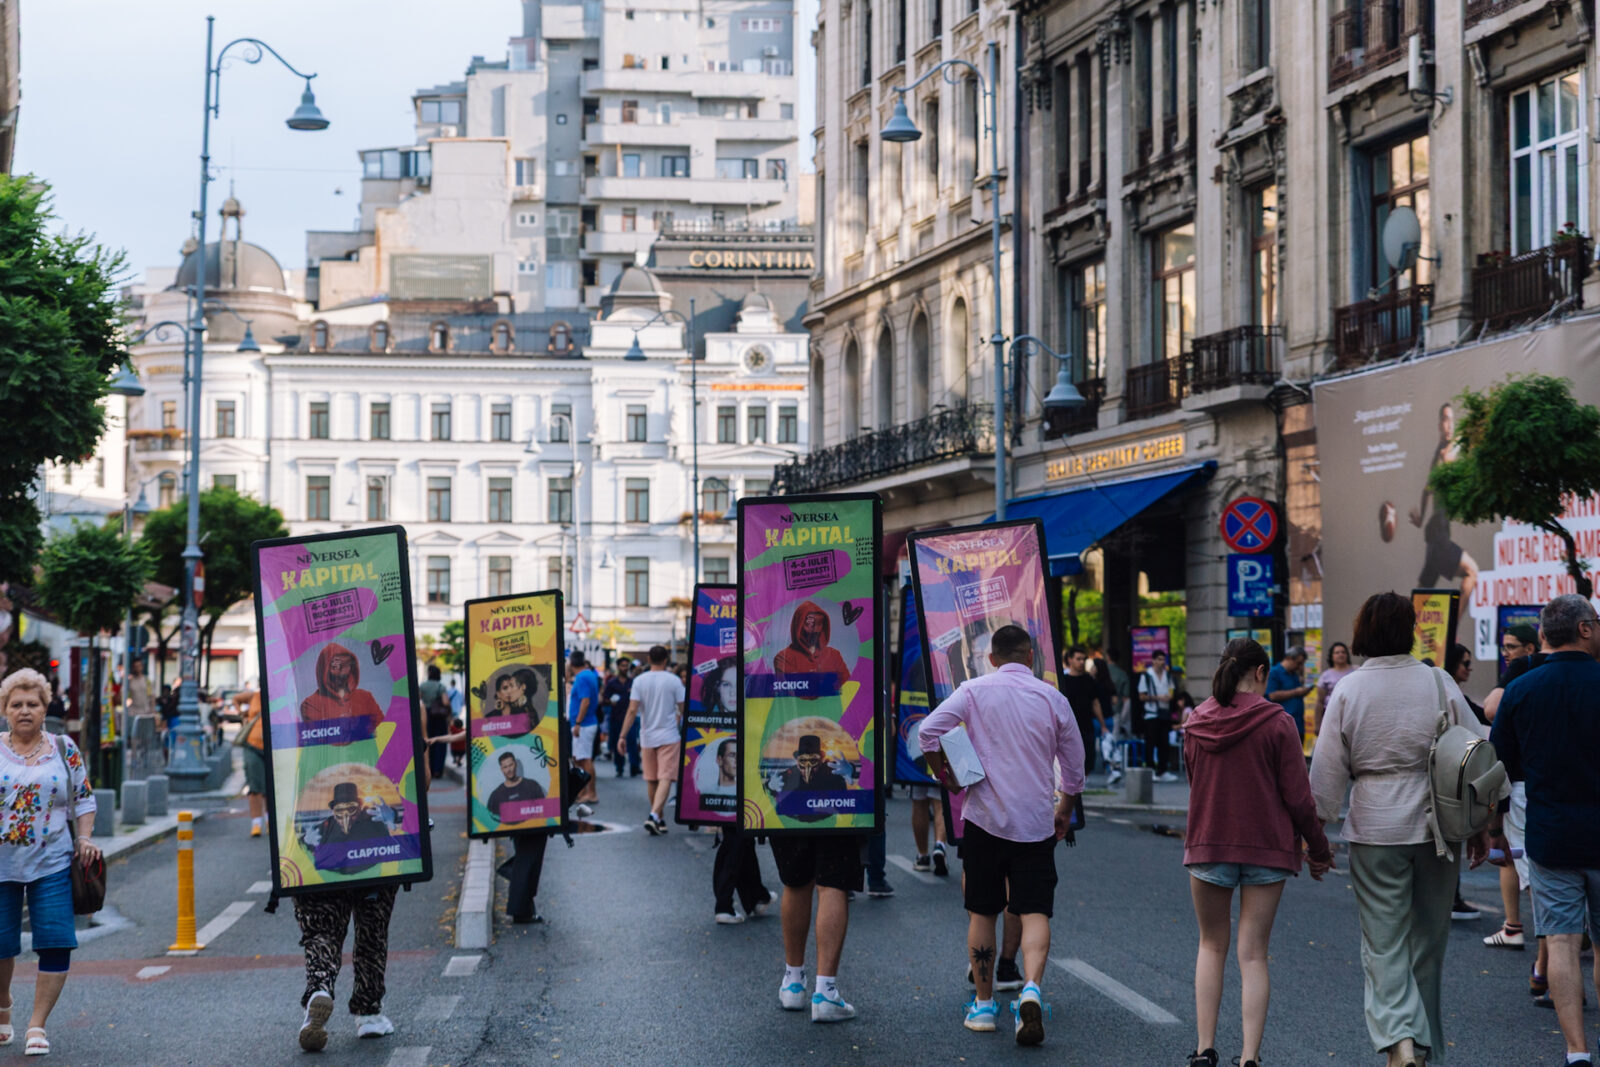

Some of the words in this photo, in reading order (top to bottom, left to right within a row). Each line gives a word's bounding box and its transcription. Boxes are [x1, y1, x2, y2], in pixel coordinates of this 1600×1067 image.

[688, 250, 815, 268] CORINTHIA
[780, 512, 839, 523] NEVERSEA
[765, 526, 854, 547] KAPITAL
[949, 538, 1004, 551] NEVERSEA
[1498, 539, 1514, 566] NU
[1518, 535, 1538, 564] FAC
[296, 549, 361, 565] NEVERSEA
[791, 561, 806, 569] 4-6
[808, 556, 829, 567] IULIE
[937, 551, 1021, 574] KAPITAL
[281, 562, 379, 591] KAPITAL
[964, 588, 980, 597] 4-6
[1475, 580, 1488, 607] LA
[1492, 576, 1533, 606] JOCURI
[1538, 575, 1552, 602] DE
[330, 595, 352, 607] IULIE
[491, 604, 532, 615] NEVERSEA
[480, 613, 543, 634] KAPITAL
[773, 680, 809, 690] SICKICK
[688, 716, 722, 724] CHARLOTTE
[724, 716, 732, 724] DE
[301, 726, 341, 740] SICKICK
[806, 798, 856, 808] CLAPTONE
[347, 844, 401, 860] CLAPTONE
